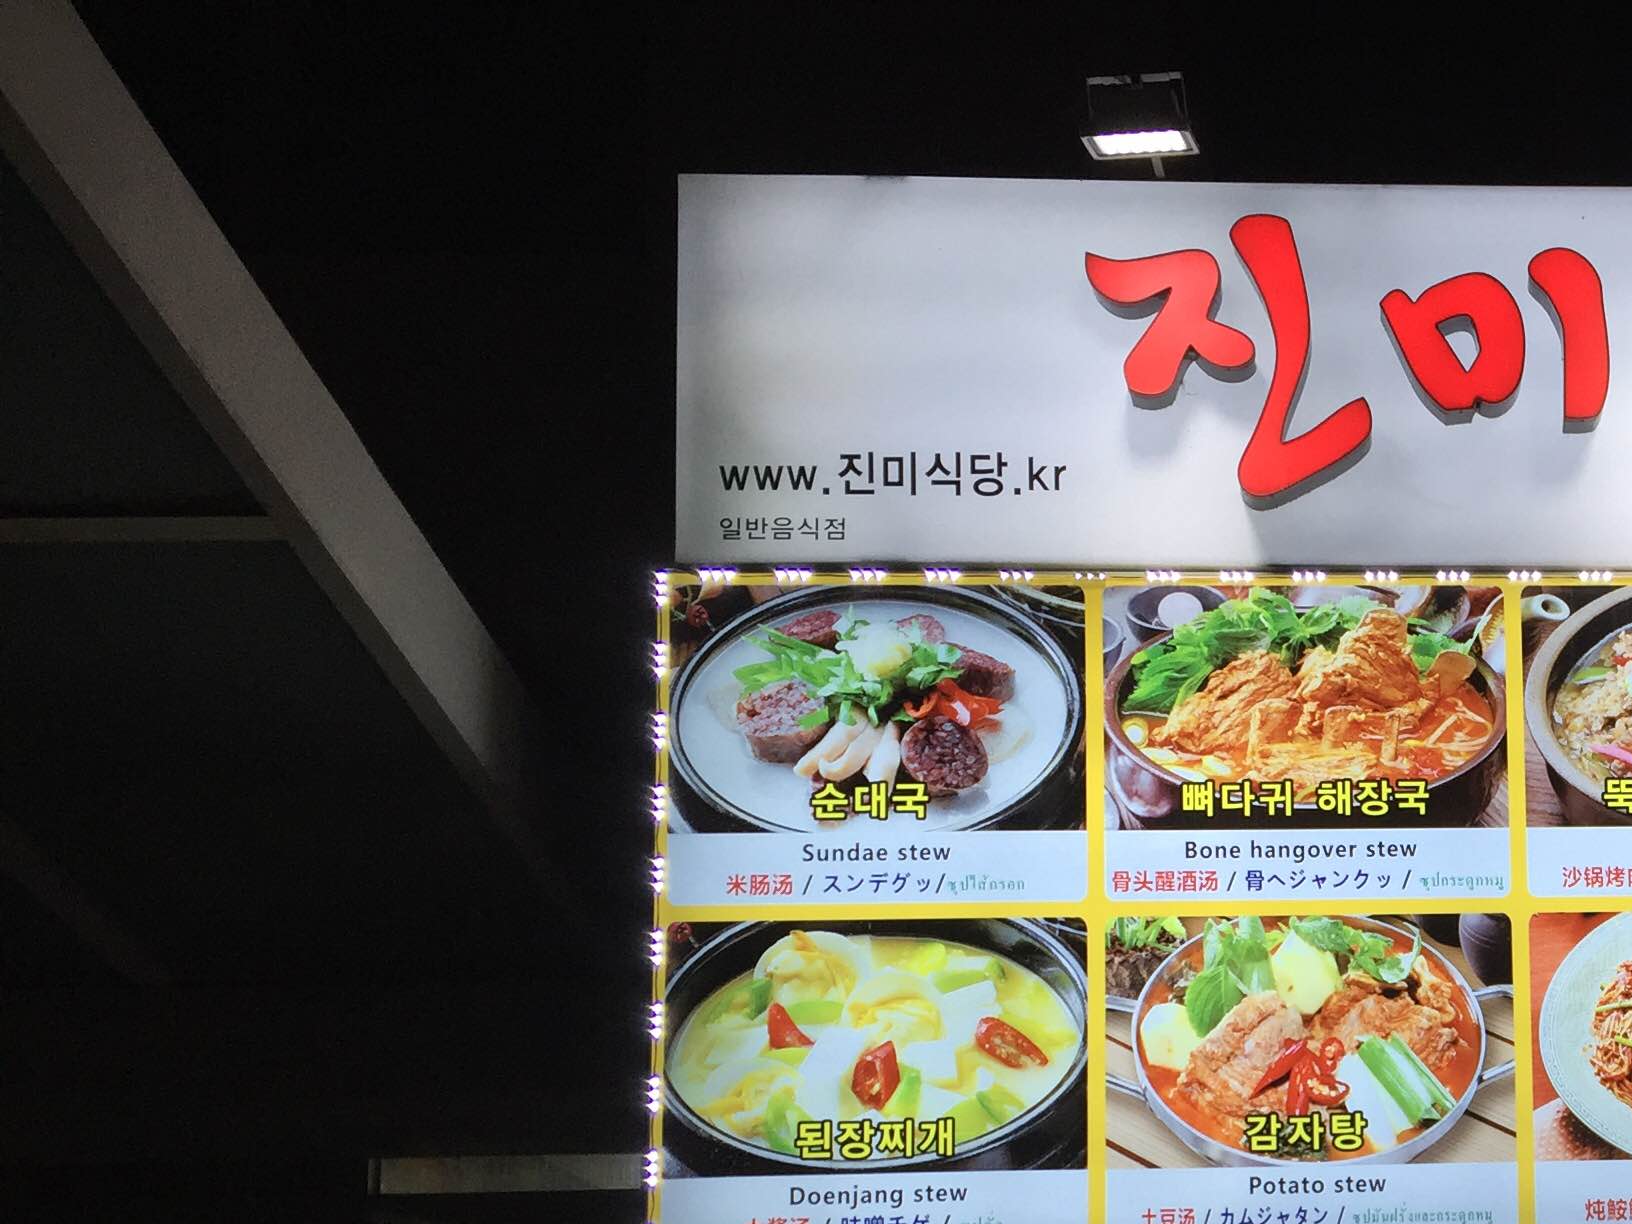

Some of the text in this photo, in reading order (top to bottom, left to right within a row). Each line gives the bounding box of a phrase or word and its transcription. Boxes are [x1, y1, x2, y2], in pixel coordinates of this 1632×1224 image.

[719, 451, 1067, 497] www.진미식당.kr
[718, 515, 847, 541] 일반음식점
[810, 781, 931, 820] 순대국
[1180, 779, 1432, 818] 뼈다귀 해장국
[802, 843, 952, 863] Sundae stew
[1185, 841, 1418, 864] Bone hangover stew
[726, 874, 793, 896] 米肠汤
[1111, 870, 1218, 893] 骨头醒酒汤
[795, 1116, 957, 1161] 된장찌개
[1244, 1111, 1369, 1152] 감자탕
[789, 1184, 968, 1208] Doenjang stew
[1249, 1175, 1387, 1195] Potato stew
